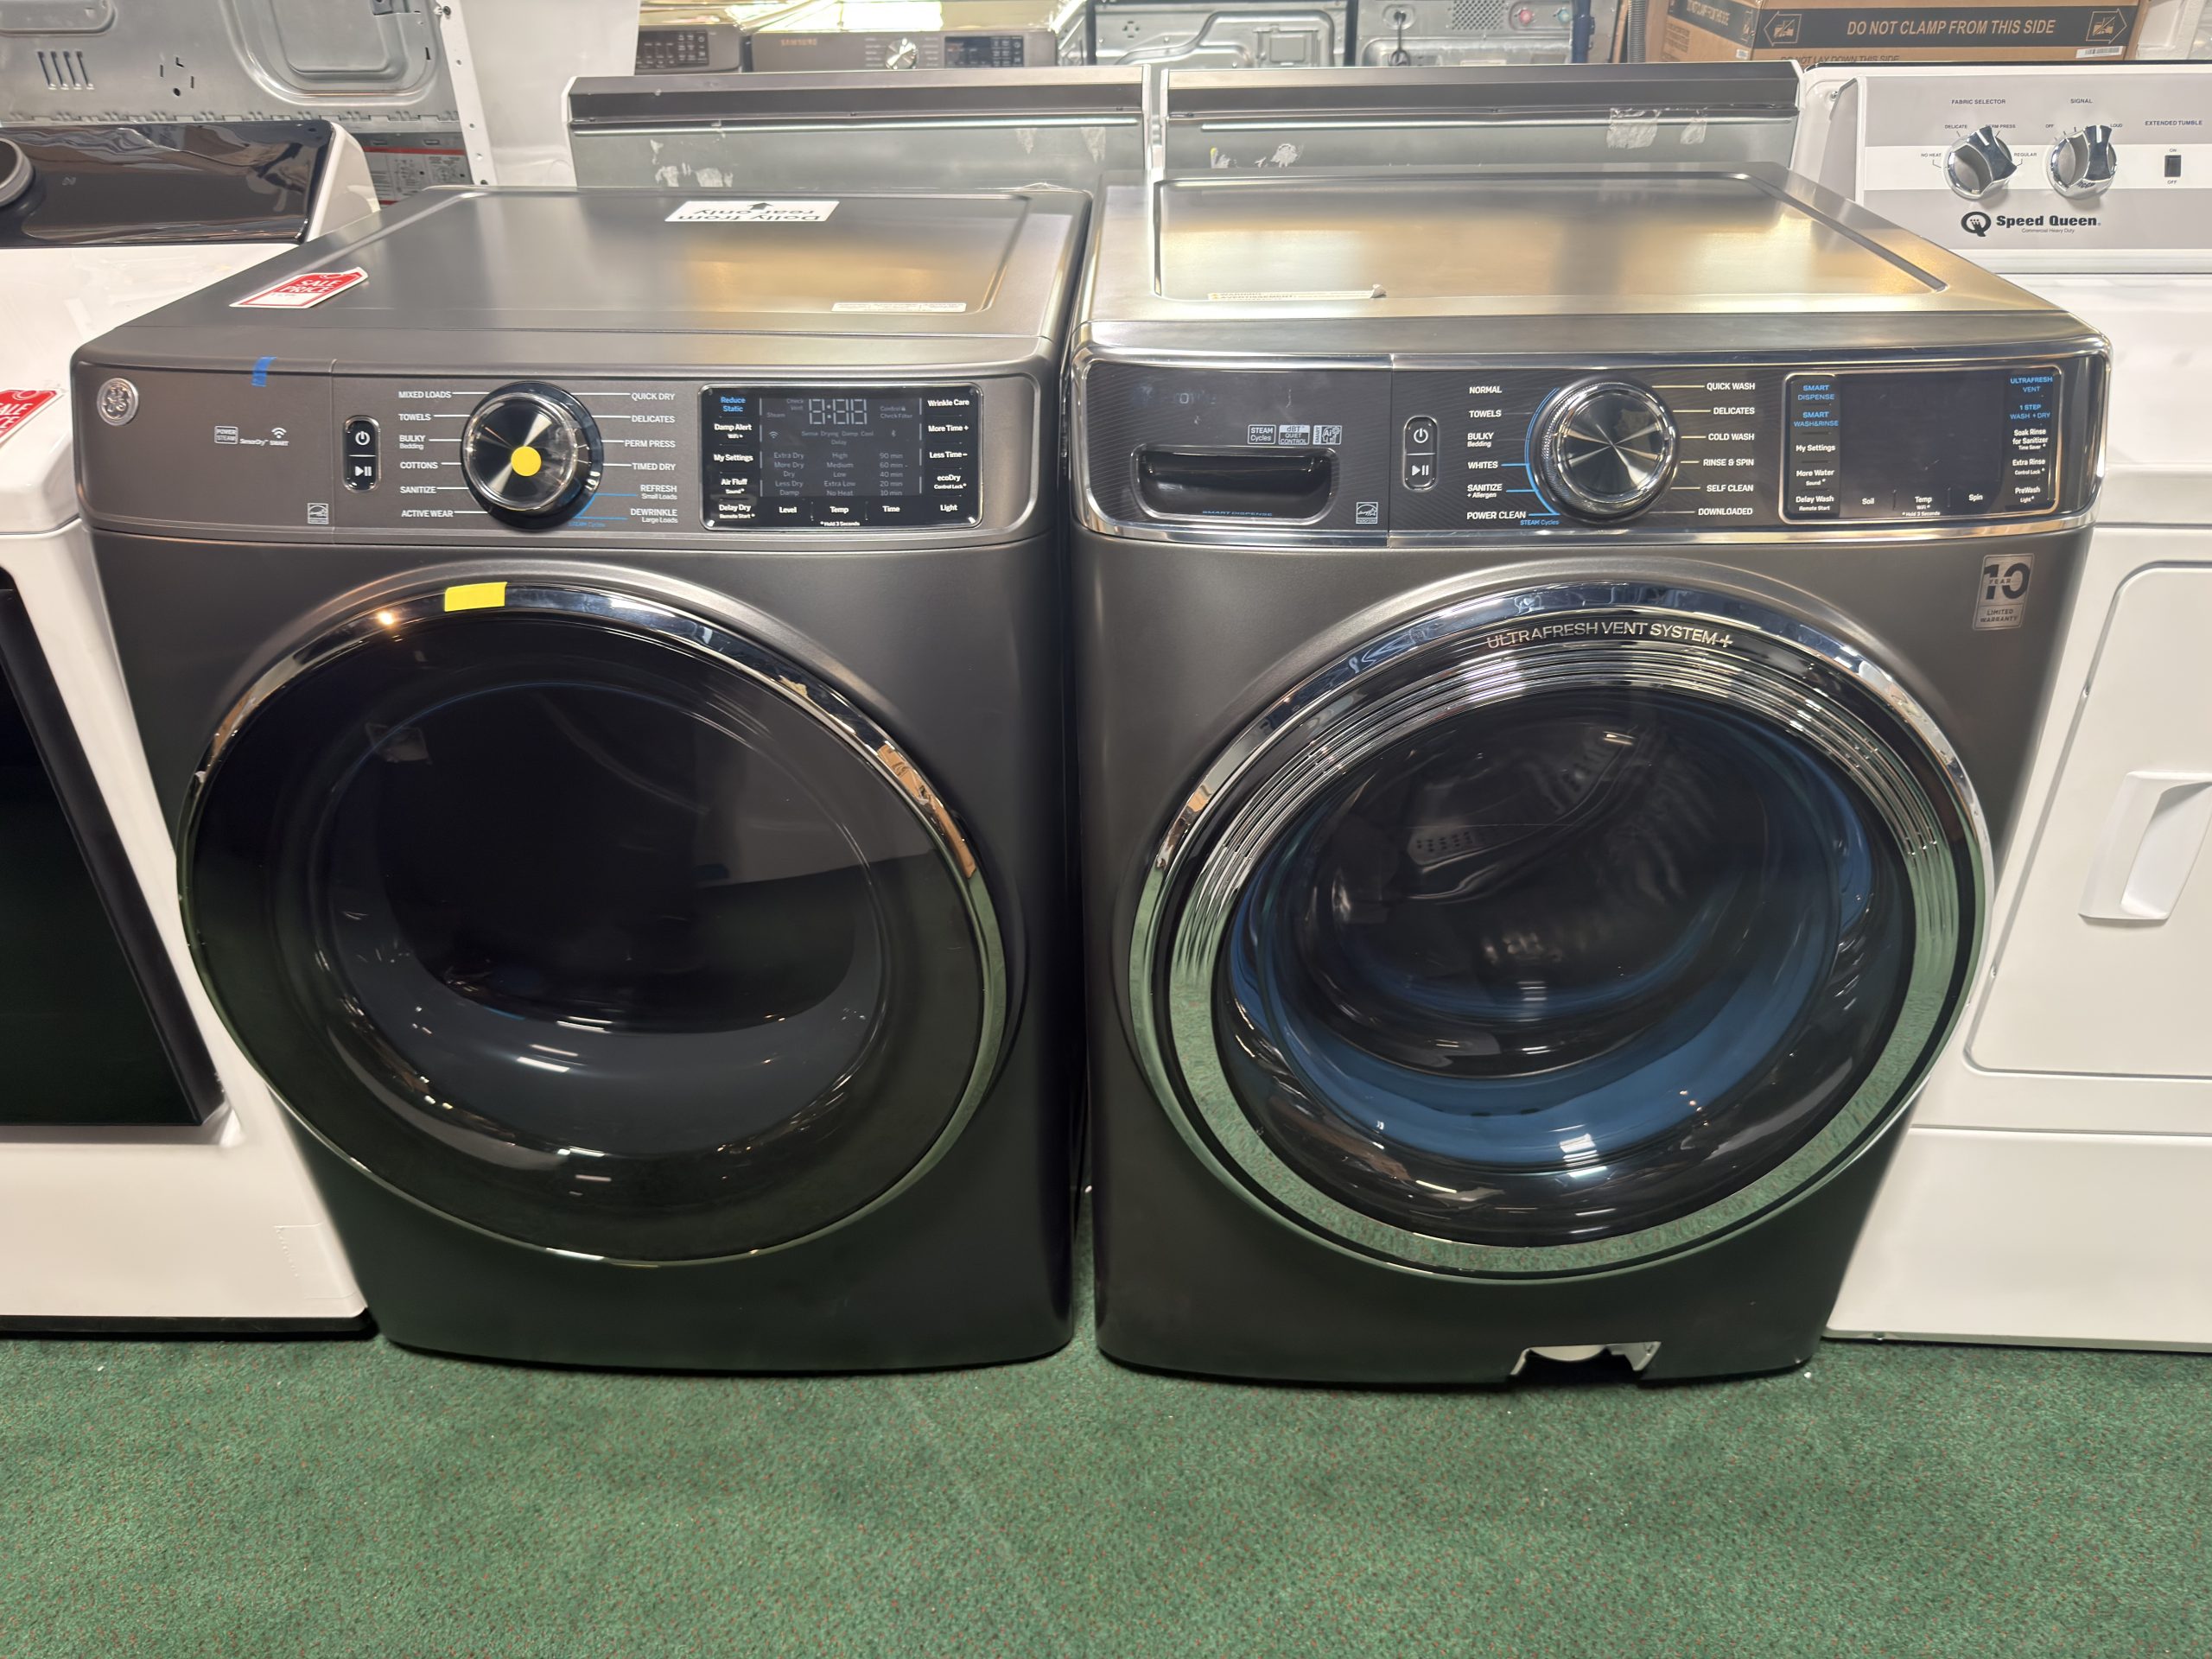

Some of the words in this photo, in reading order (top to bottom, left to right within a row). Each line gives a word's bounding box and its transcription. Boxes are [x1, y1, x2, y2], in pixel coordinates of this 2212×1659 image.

[1847, 22, 1866, 35] DO
[1869, 22, 1897, 35] NOT
[1901, 21, 1946, 35] CLAMP
[1948, 21, 1987, 35] FROM
[1991, 20, 2021, 35] THIS
[2024, 20, 2056, 34] SIDE
[1997, 216, 2044, 228] Speed
[2050, 216, 2096, 226] Queen
[1983, 563, 2031, 600] 10
[1487, 622, 1598, 649] ULTRAFRESH
[1602, 622, 1648, 635] VENT
